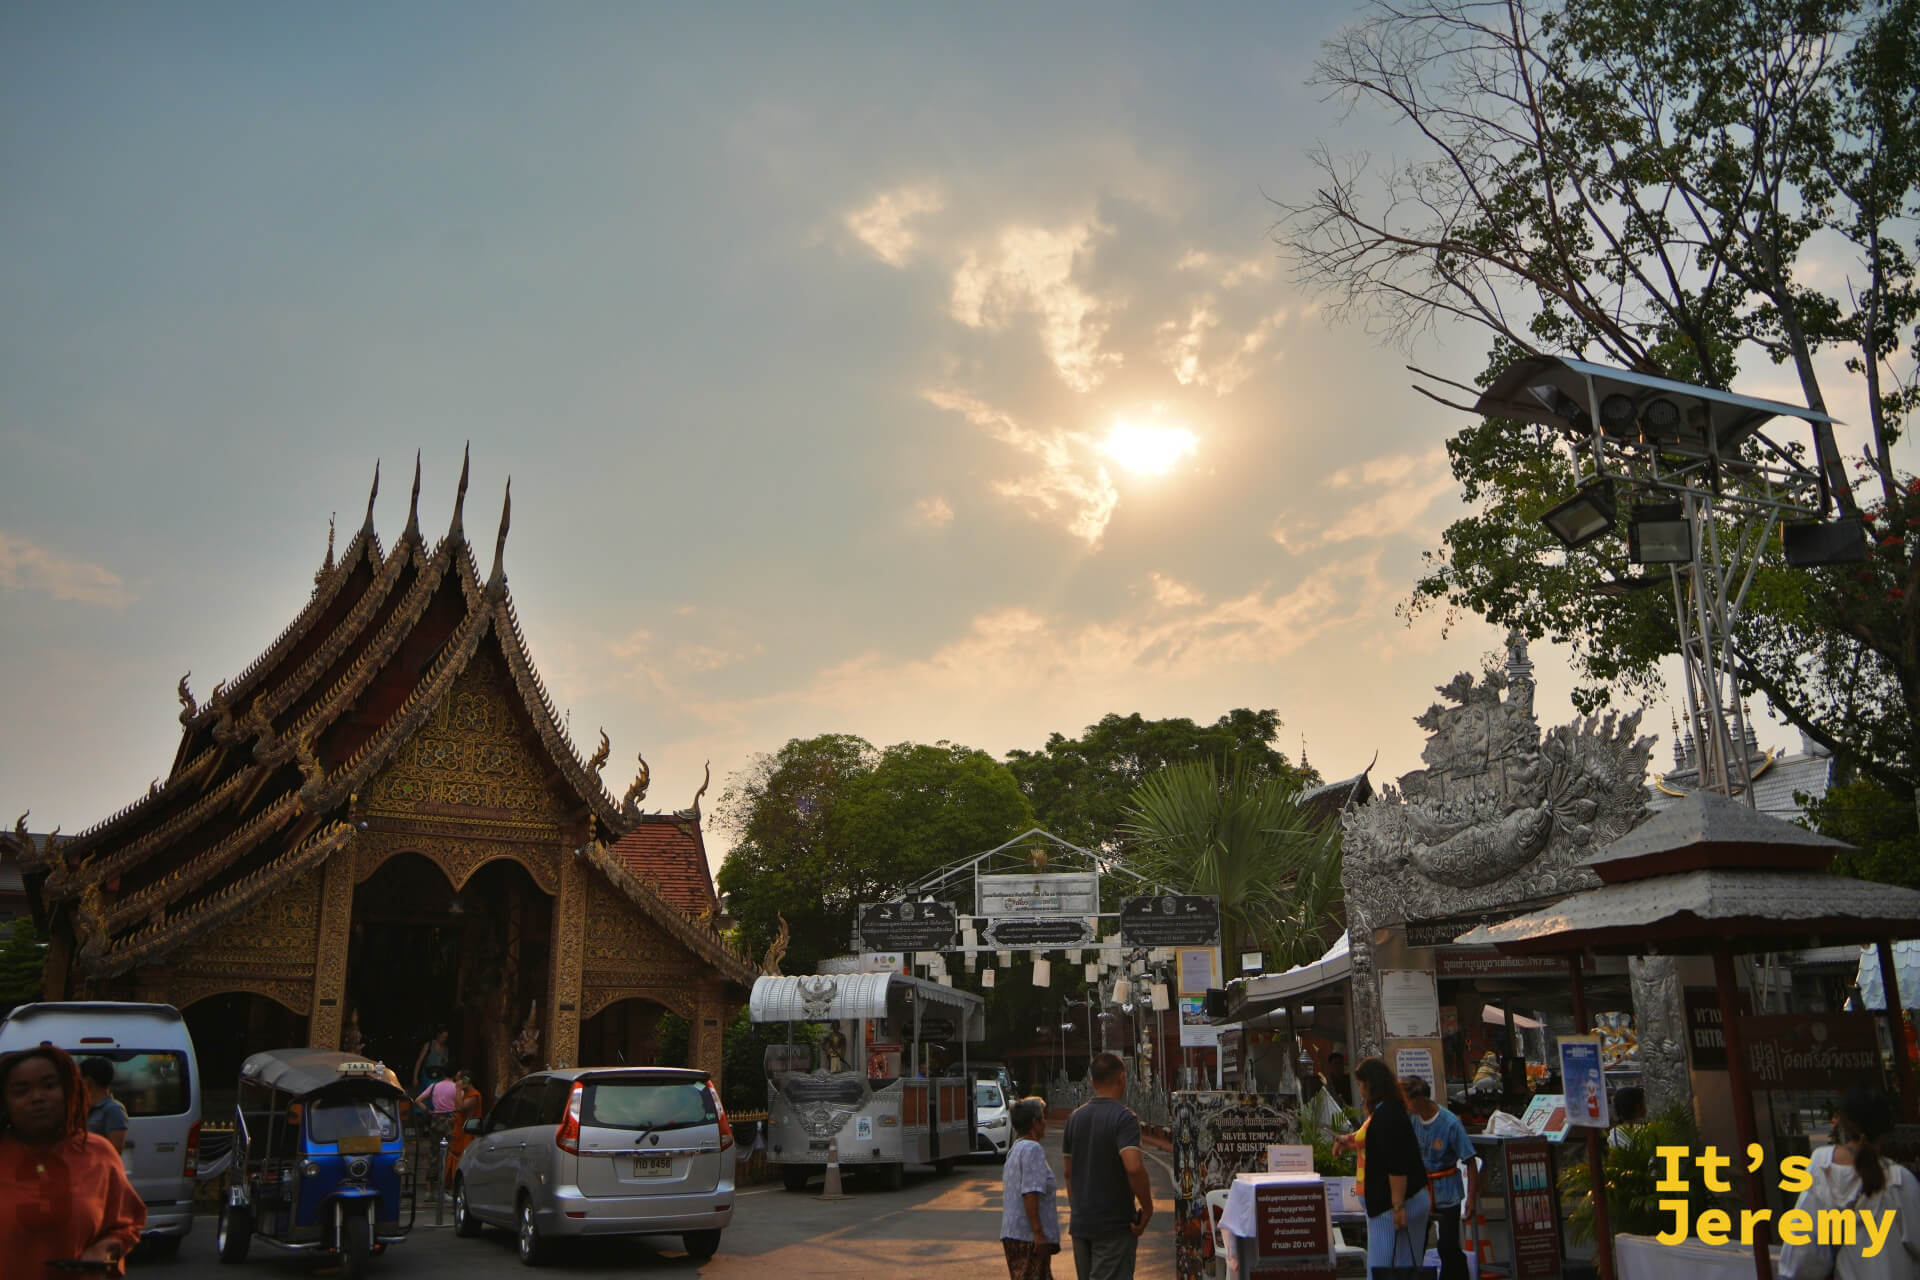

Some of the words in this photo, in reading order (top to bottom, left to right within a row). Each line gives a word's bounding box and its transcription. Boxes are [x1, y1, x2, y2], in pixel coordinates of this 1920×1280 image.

[1694, 1028, 1726, 1048] ENTR
[1222, 1131, 1247, 1141] SILVER
[1249, 1131, 1274, 1141] TEMPLE
[1216, 1142, 1235, 1152] WAT
[1236, 1142, 1281, 1152] SRISUP
